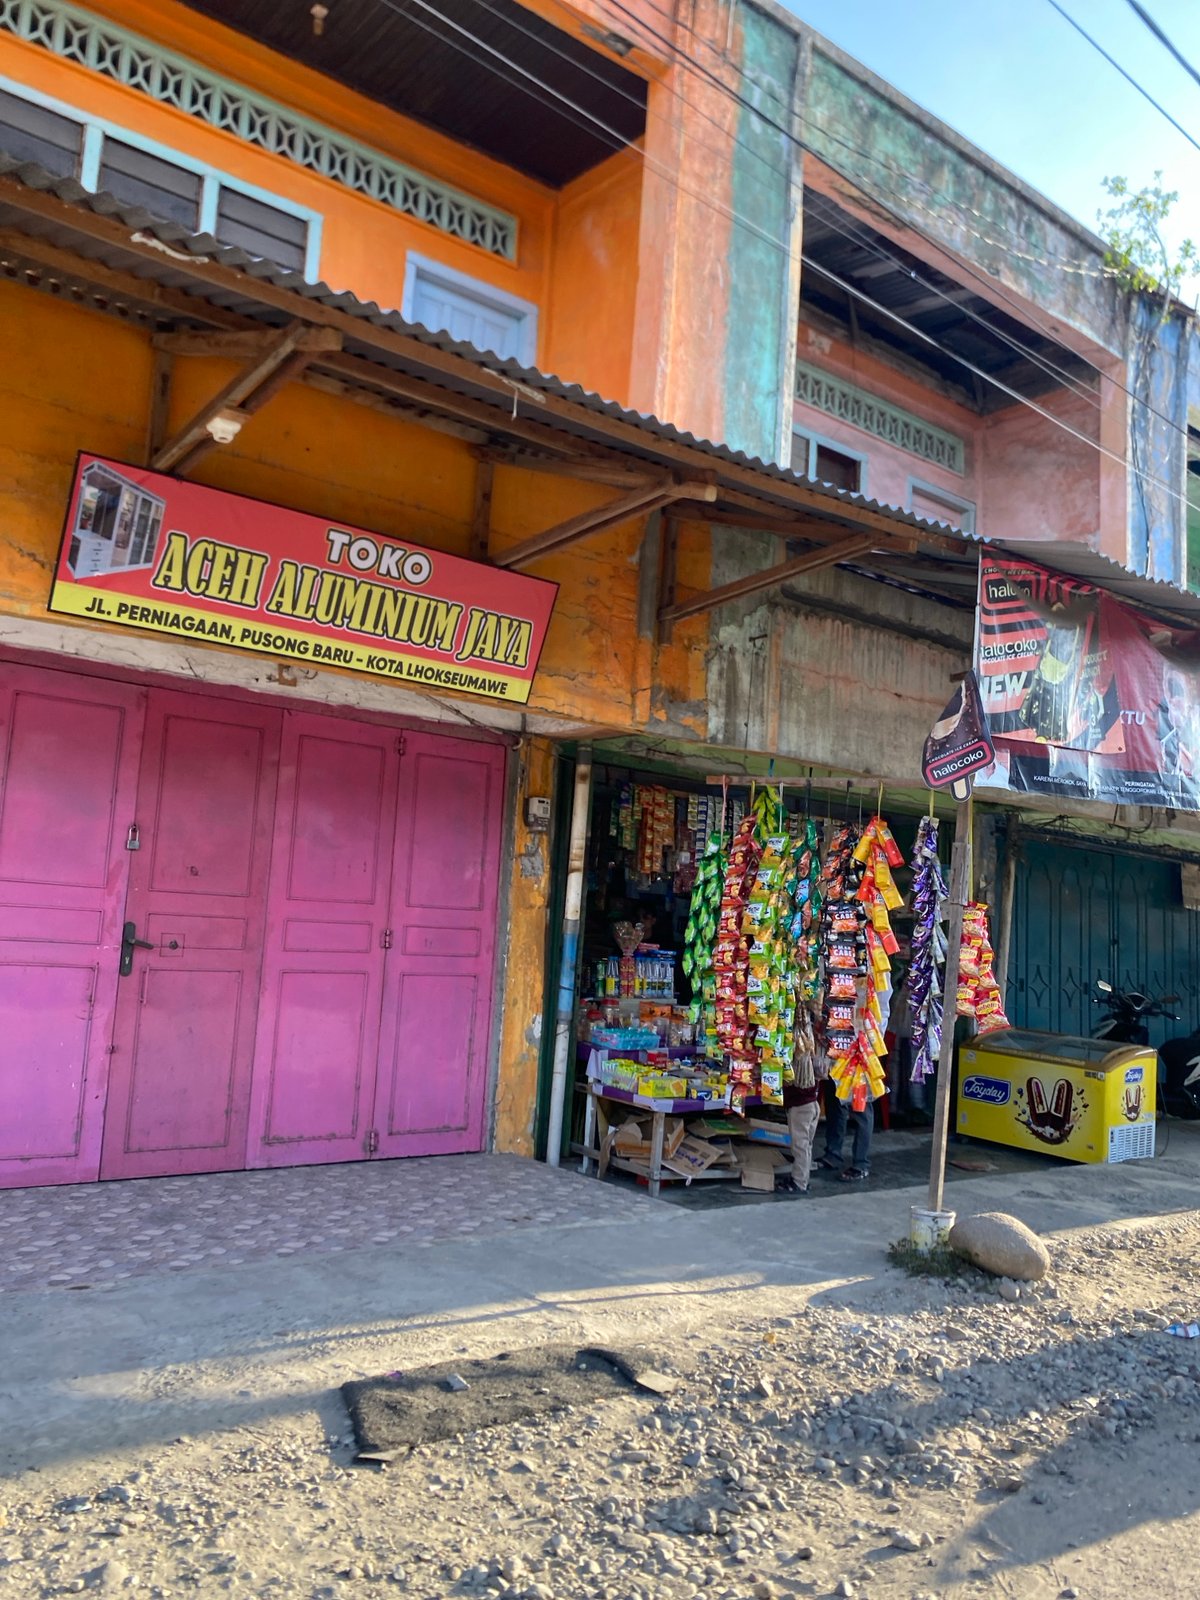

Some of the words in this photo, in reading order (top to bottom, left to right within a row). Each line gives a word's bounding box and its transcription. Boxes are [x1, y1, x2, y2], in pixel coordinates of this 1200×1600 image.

[327, 529, 432, 586] TOKO
[154, 533, 267, 607] ACEH
[267, 562, 461, 652] ALUMINIUM
[457, 607, 533, 667] JAYA
[85, 597, 112, 616] JL.
[117, 602, 237, 643] PERNIAGAAN,
[240, 627, 309, 655] PUSONG
[312, 643, 353, 664] BARU
[366, 655, 405, 676] KOTA
[407, 664, 508, 695] LHOKSEUMAWE
[932, 750, 984, 779] halocoko
[963, 738, 979, 748] CREAM
[964, 1079, 1006, 1102] Joyday
